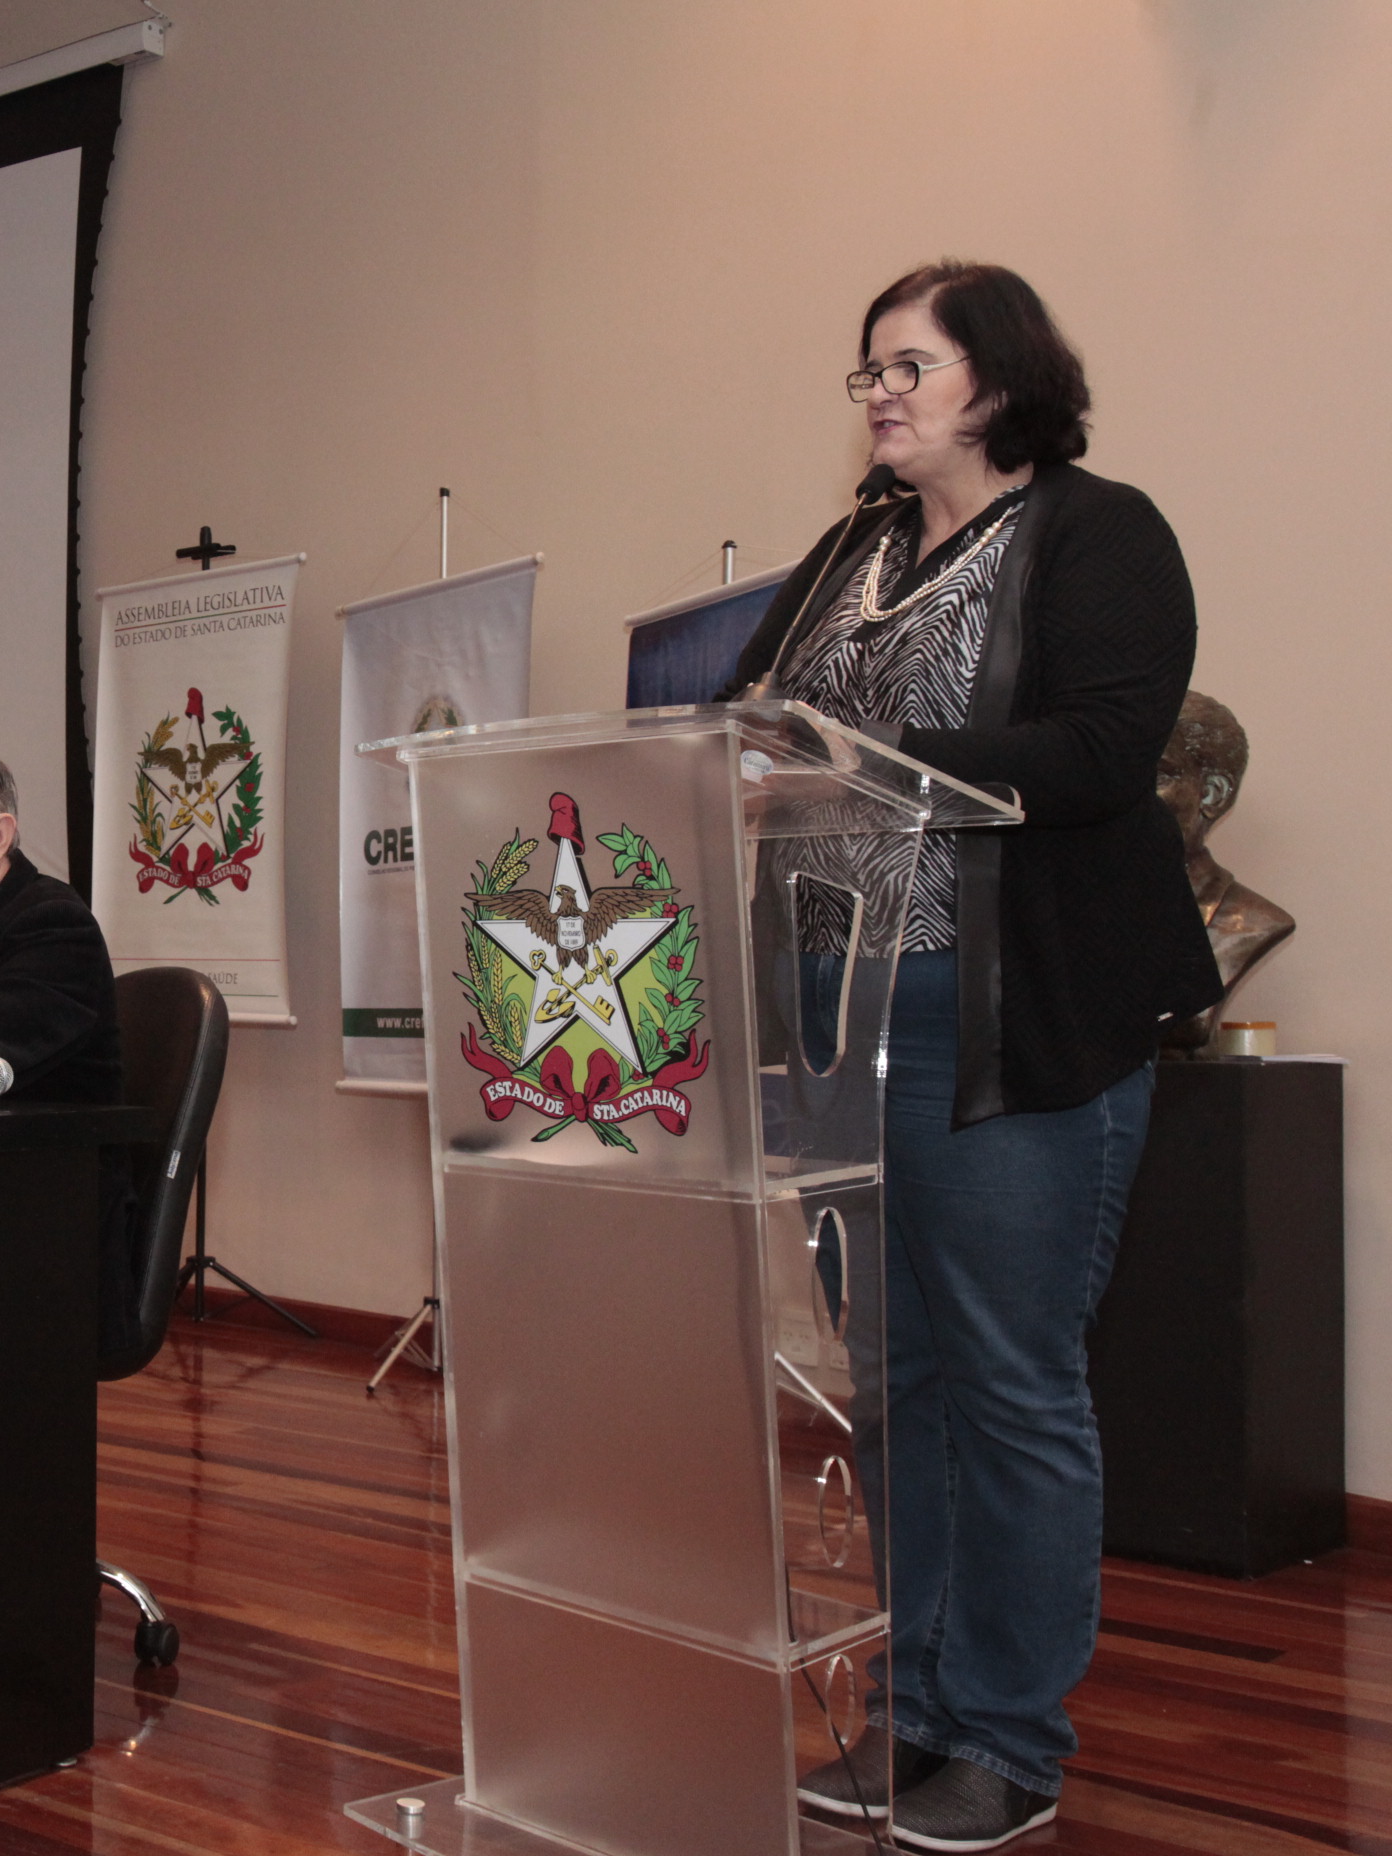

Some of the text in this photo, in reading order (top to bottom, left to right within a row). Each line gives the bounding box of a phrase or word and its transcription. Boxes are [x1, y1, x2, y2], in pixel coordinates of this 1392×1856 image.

[115, 585, 285, 626] ASSEMBLEIA LEGISLATIVA
[114, 611, 286, 648] DO ESTADO DE SANTA CATARINA
[139, 867, 180, 886] ESTADO DE
[213, 864, 249, 882] CATARINA
[486, 1080, 565, 1116] ESTADO DE
